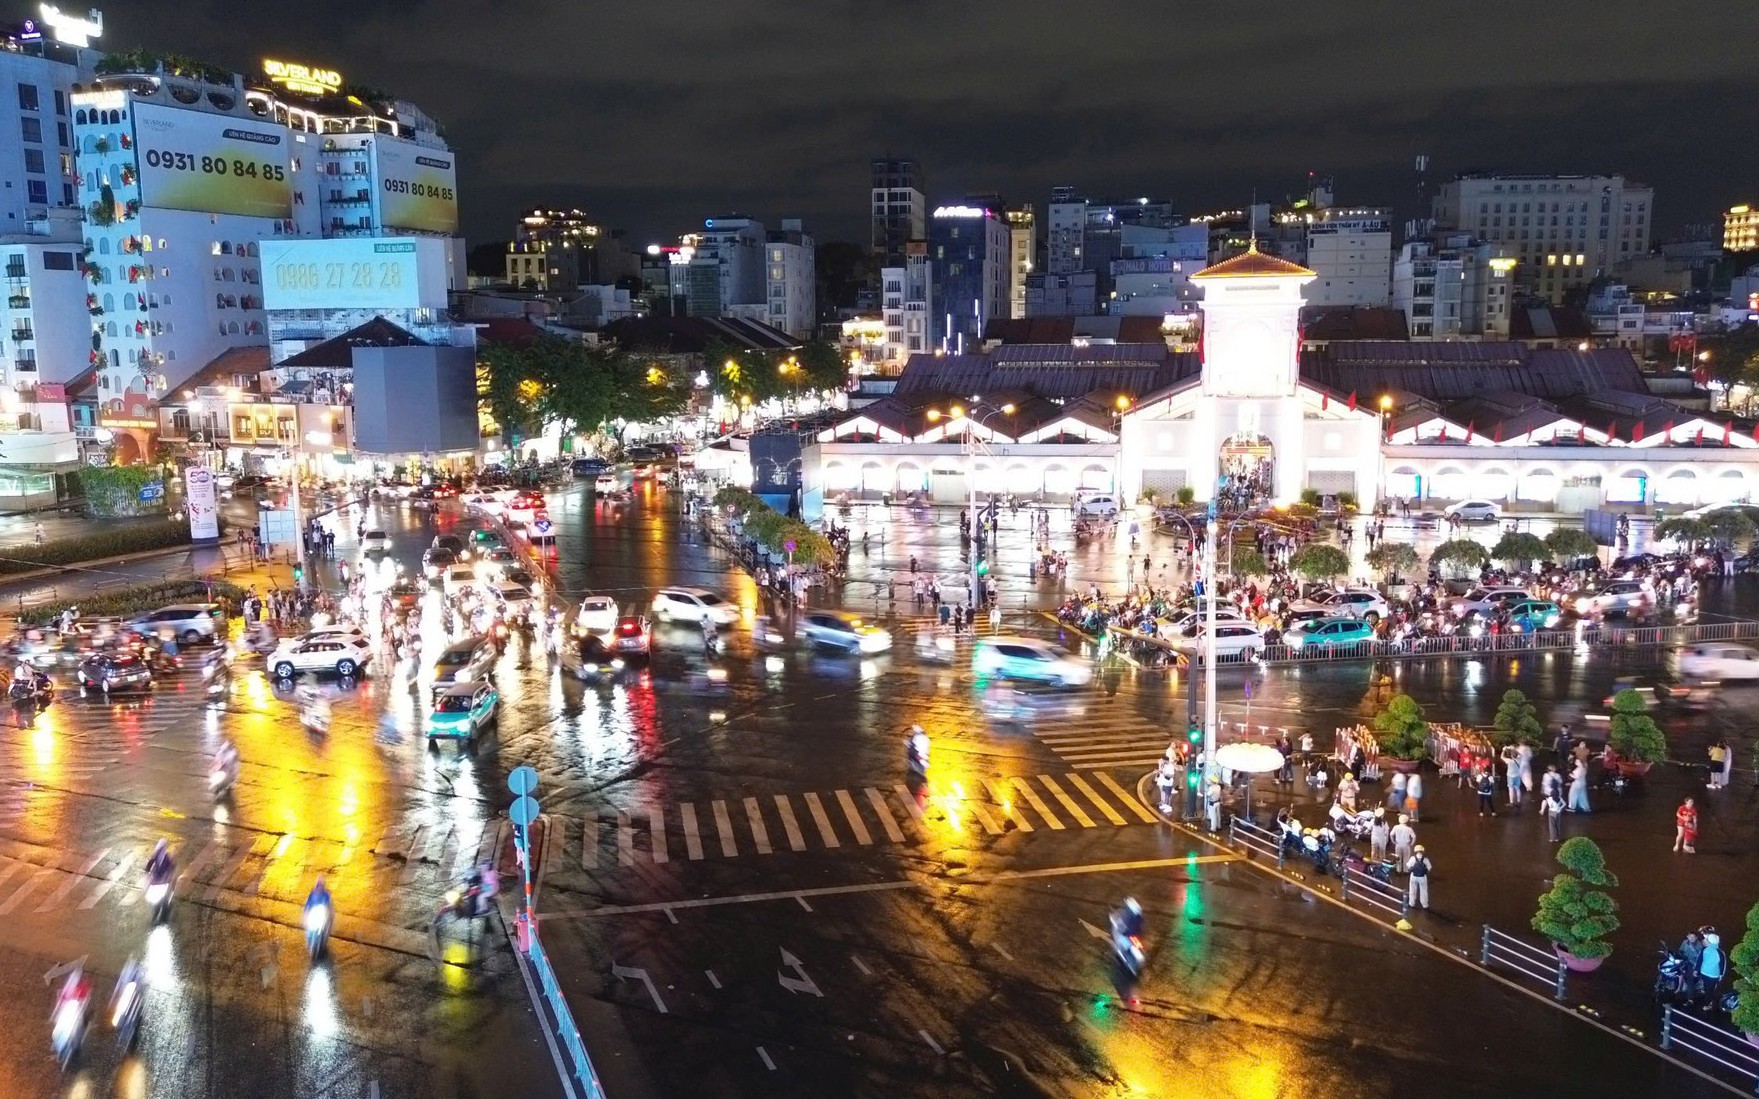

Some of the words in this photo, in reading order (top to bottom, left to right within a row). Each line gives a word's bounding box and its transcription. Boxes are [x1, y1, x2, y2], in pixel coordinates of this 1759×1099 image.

[264, 59, 341, 87] SILVERLAND
[228, 129, 240, 138] LIÊN
[146, 149, 195, 171] 0931
[201, 156, 227, 175] 80
[233, 160, 258, 178] 84
[262, 163, 285, 182] 85
[384, 178, 409, 194] 0931
[411, 182, 425, 196] 80
[427, 185, 440, 199] 84
[441, 188, 453, 200] 85
[276, 263, 319, 290] 0986
[325, 263, 345, 289] 27
[351, 262, 372, 289] 28
[380, 262, 400, 288] 28
[1148, 260, 1173, 271] HOTEL
